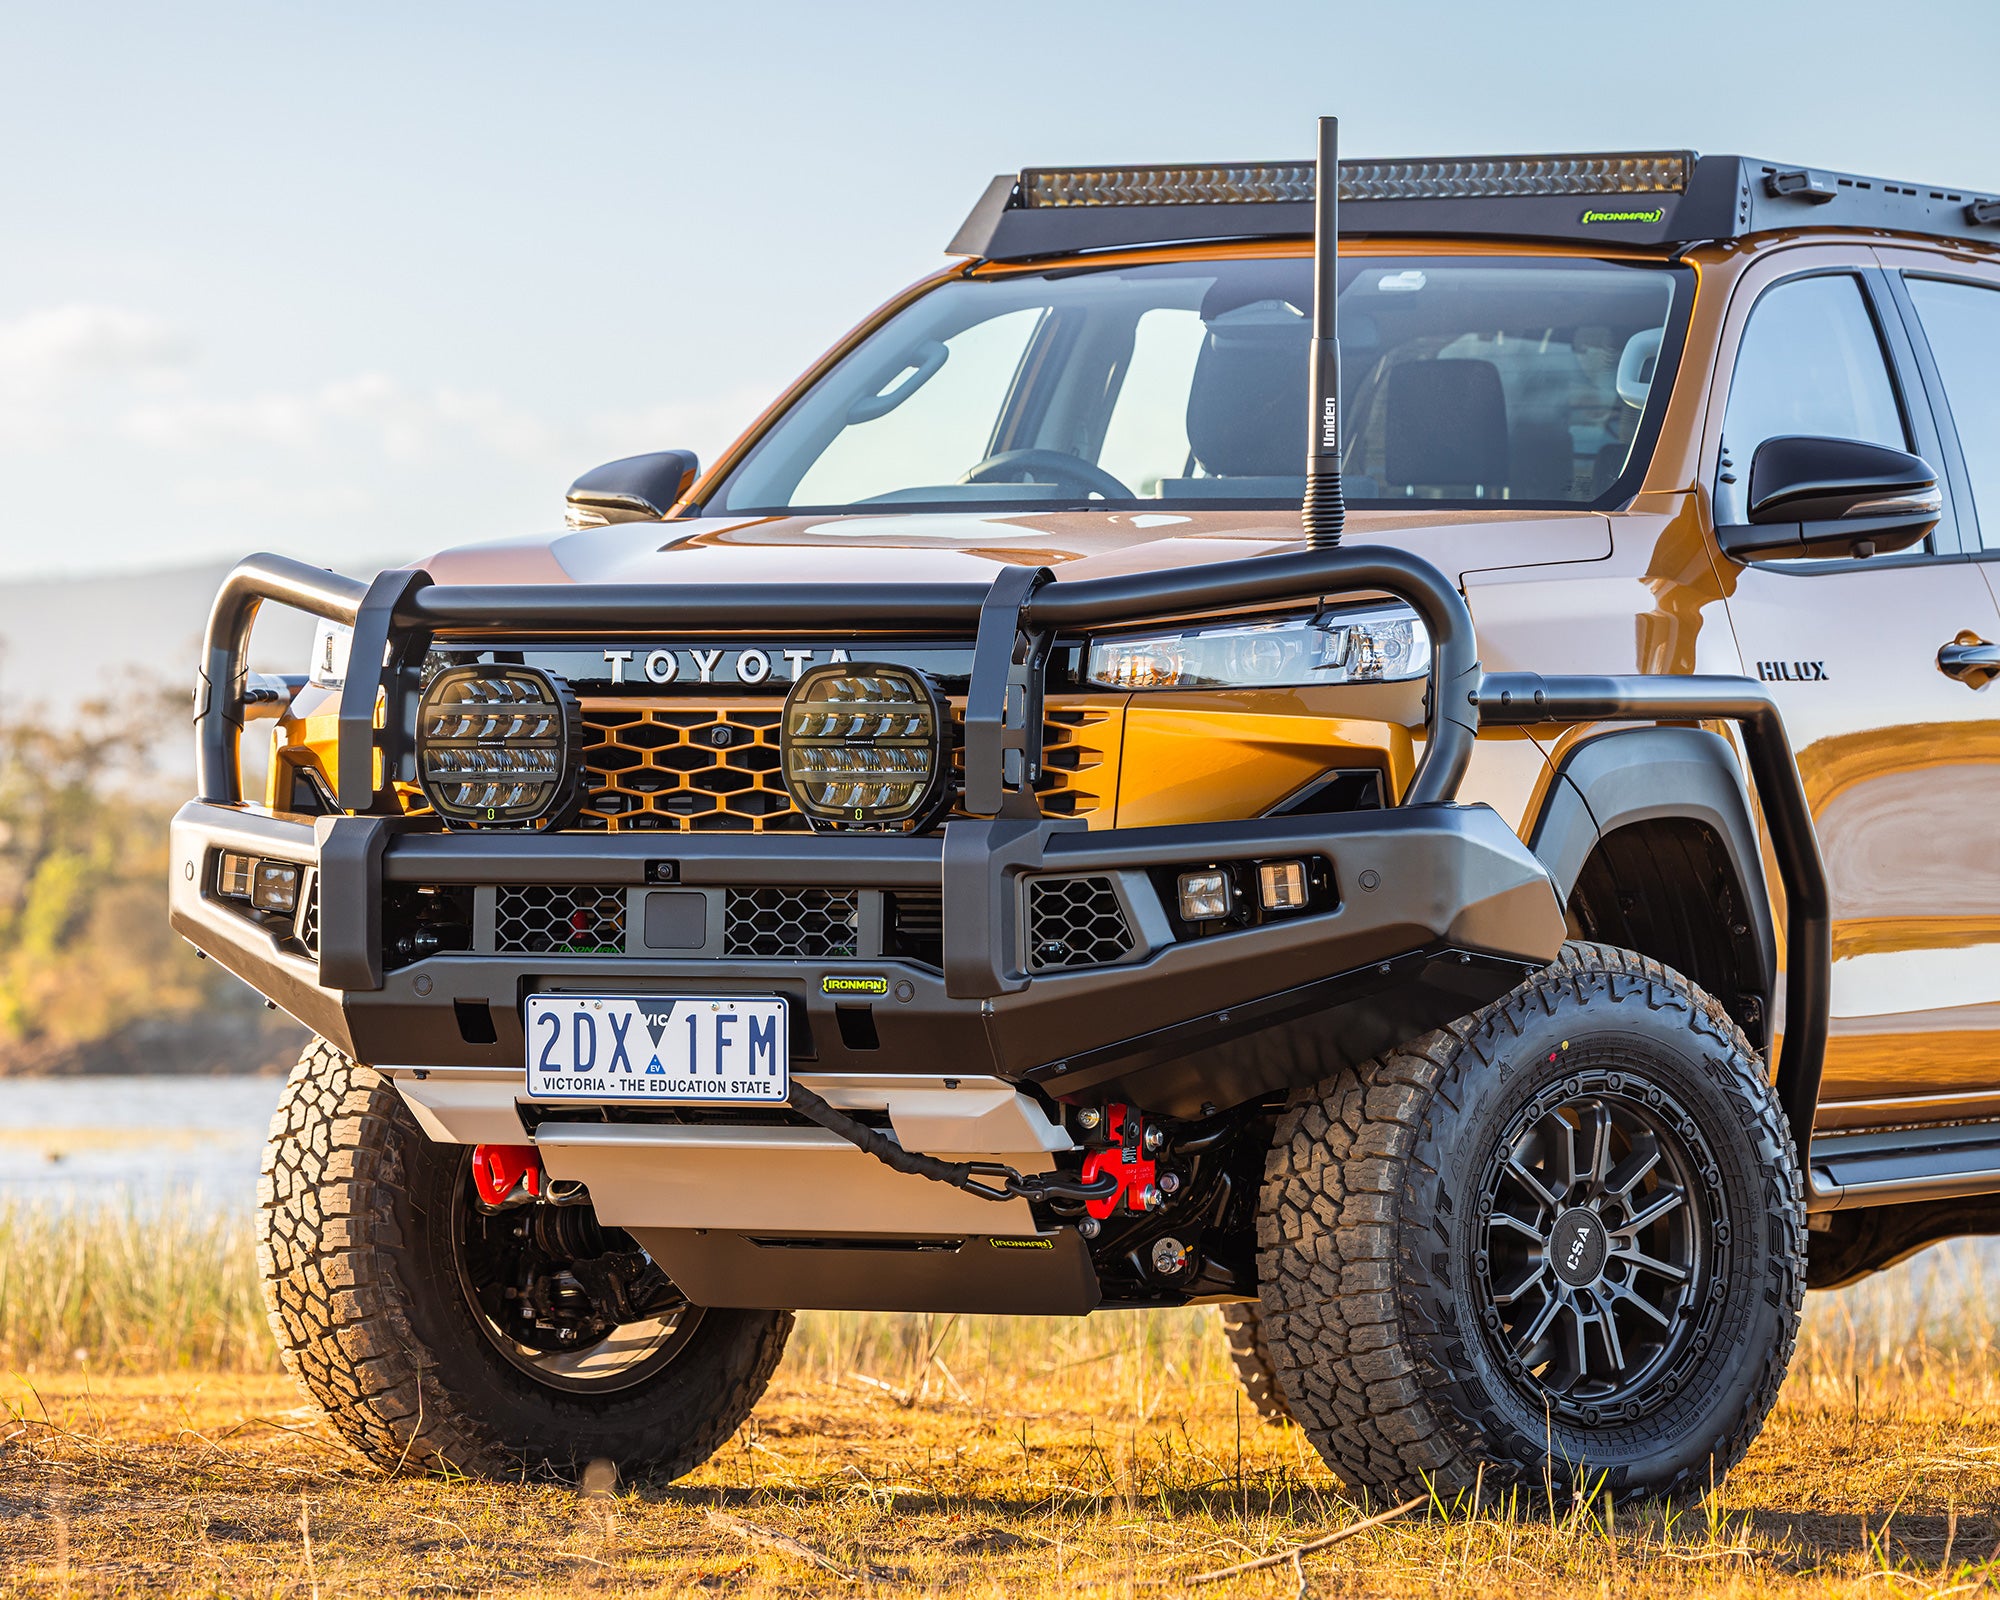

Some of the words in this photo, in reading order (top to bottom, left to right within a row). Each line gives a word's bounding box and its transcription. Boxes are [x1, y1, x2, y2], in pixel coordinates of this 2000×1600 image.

[1589, 211, 1655, 221] IRONMAN
[1756, 661, 1830, 681] HILUX
[828, 980, 882, 990] IRONMAN
[642, 1013, 669, 1027] VIC
[537, 1011, 633, 1073] 2DX
[685, 1013, 776, 1076] 1FM
[650, 1065, 661, 1073] EV
[543, 1077, 605, 1091] VICTORIA
[619, 1078, 645, 1092] THE
[650, 1079, 726, 1094] EDUCATION
[731, 1080, 771, 1094] STATE
[1566, 1227, 1590, 1271] CSA
